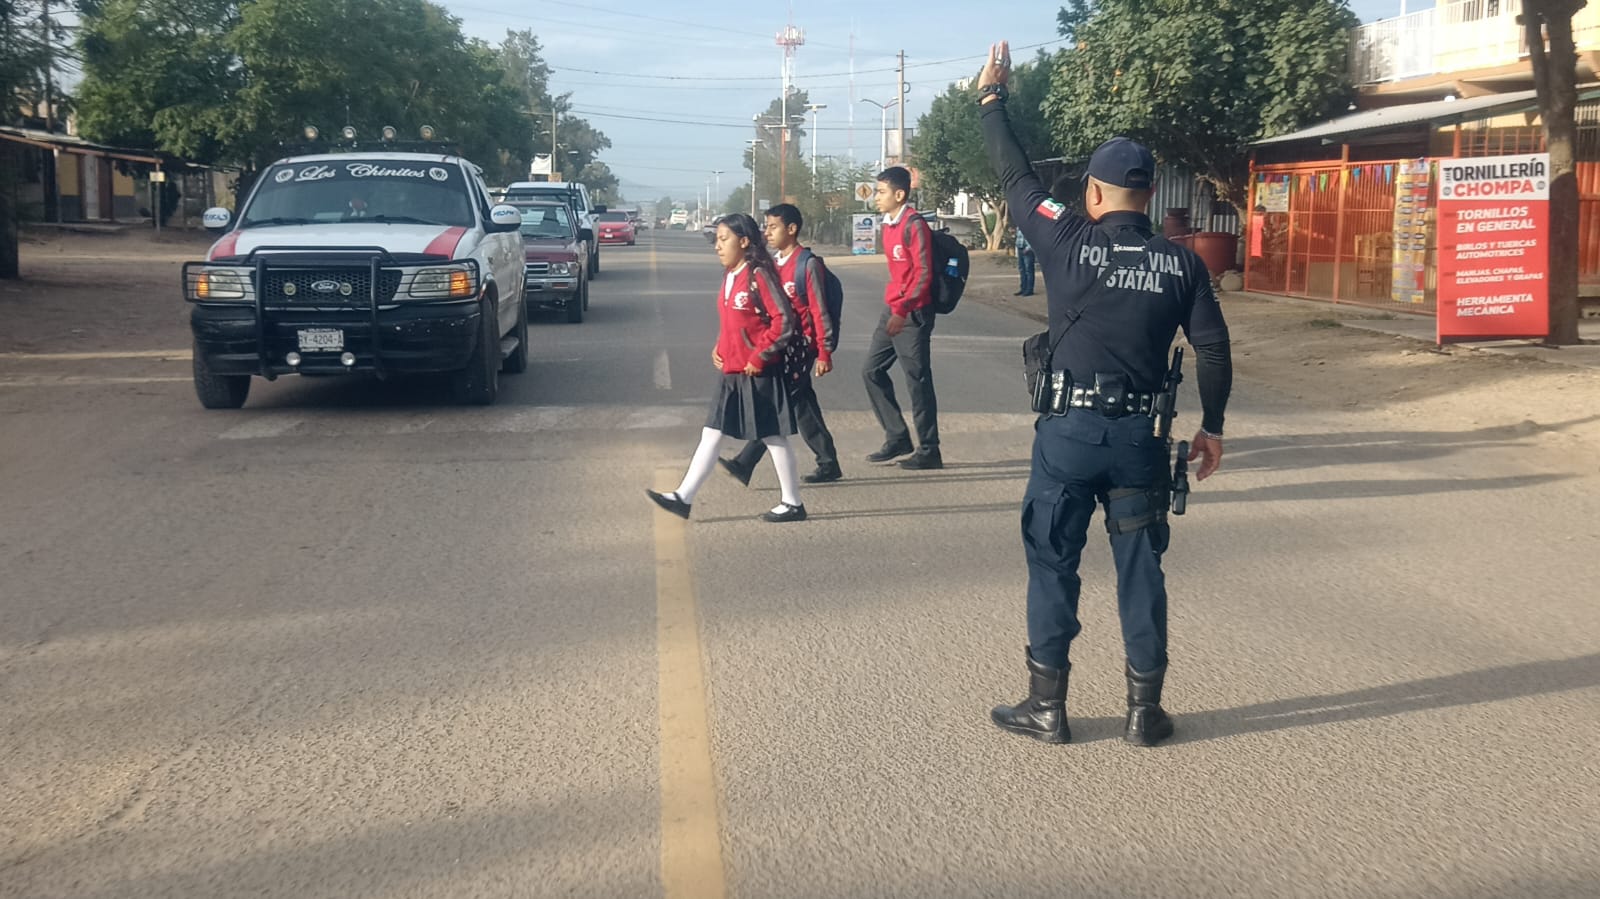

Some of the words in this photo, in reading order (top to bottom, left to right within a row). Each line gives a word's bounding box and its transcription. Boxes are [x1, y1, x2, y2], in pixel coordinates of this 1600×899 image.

[294, 165, 336, 182] Los
[346, 163, 425, 178] Chinitos
[1443, 158, 1545, 181] TORNILLERÍA
[1454, 180, 1534, 197] CHOMPA
[1457, 206, 1529, 220] TORNILLOS
[1456, 222, 1474, 234] EN
[1477, 219, 1536, 232] GENERAL
[1148, 251, 1183, 277] VIAL
[1457, 294, 1534, 307] HERRAMIENTA
[1457, 304, 1515, 317] MECÁNICA
